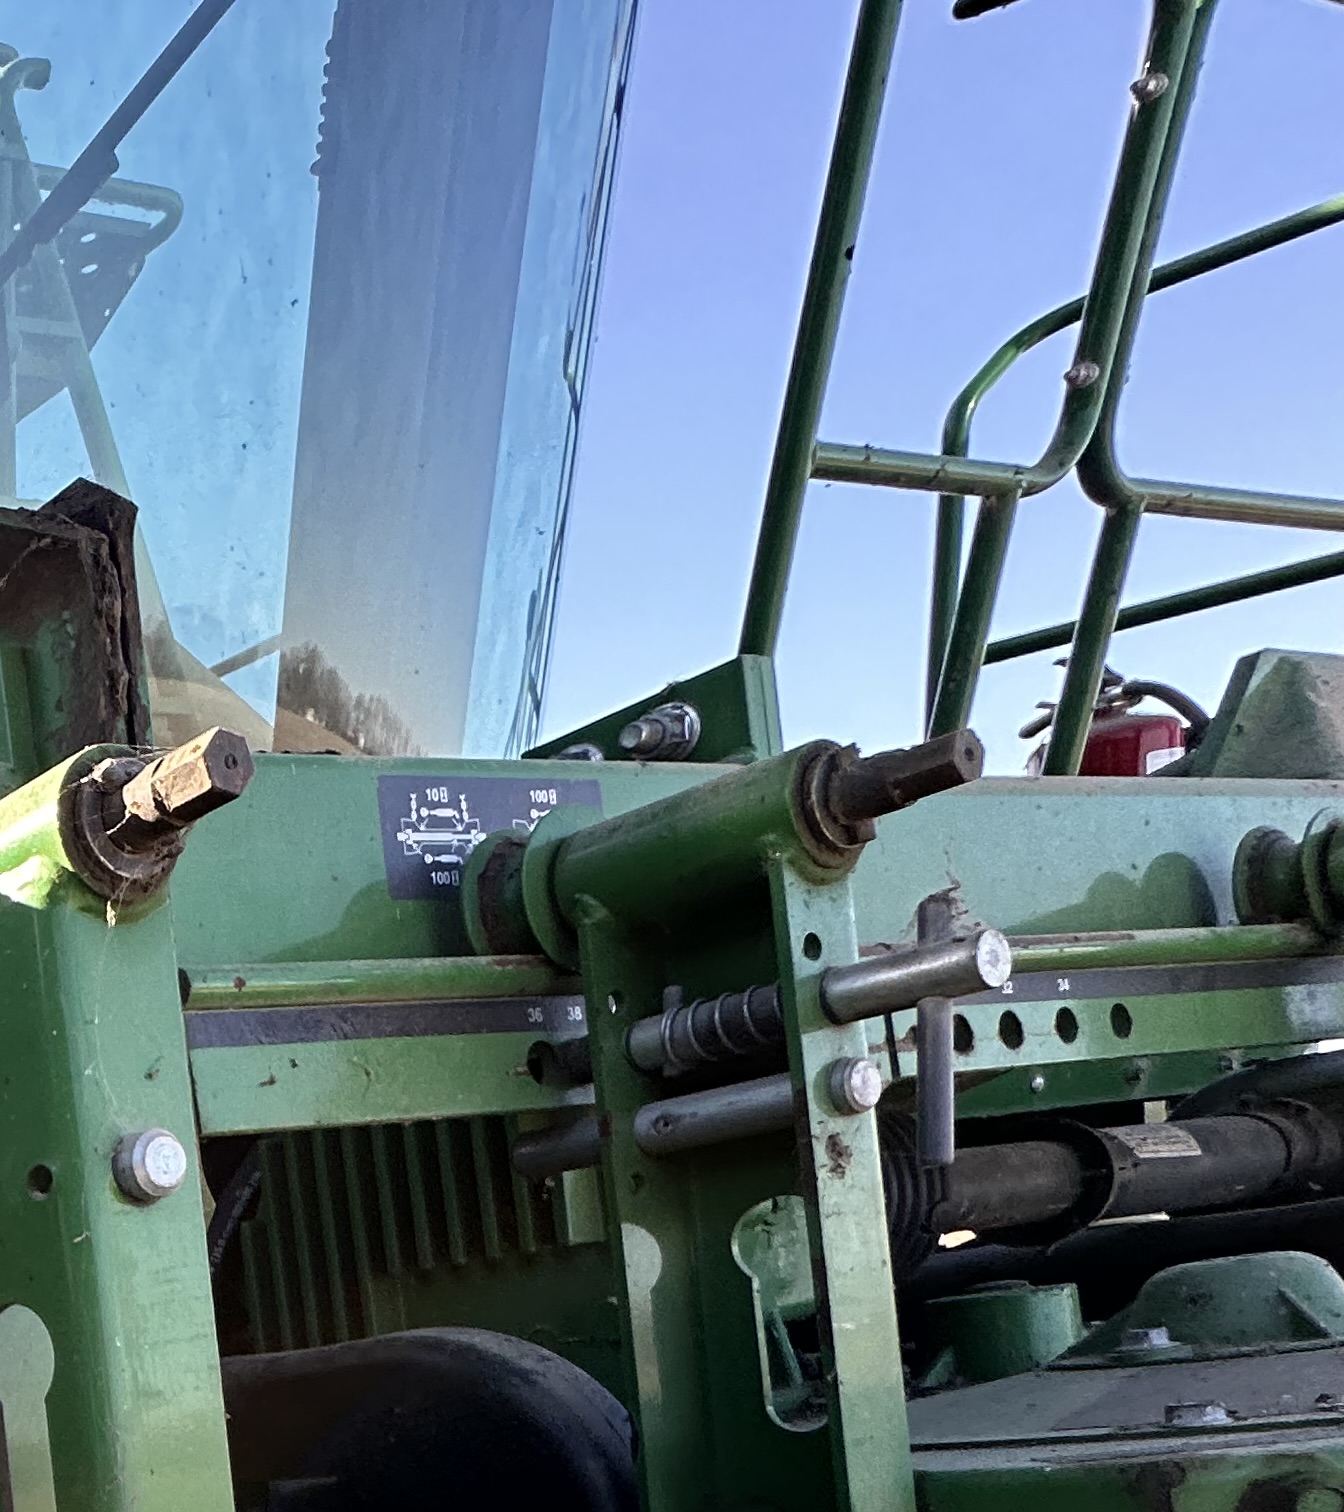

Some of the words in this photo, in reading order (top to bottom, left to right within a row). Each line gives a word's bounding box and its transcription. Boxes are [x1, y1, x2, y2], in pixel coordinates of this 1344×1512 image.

[529, 789, 548, 803] 100
[430, 871, 451, 886] 100
[1002, 980, 1014, 994] 2
[527, 1007, 544, 1023] 36
[567, 1005, 583, 1021] 38
